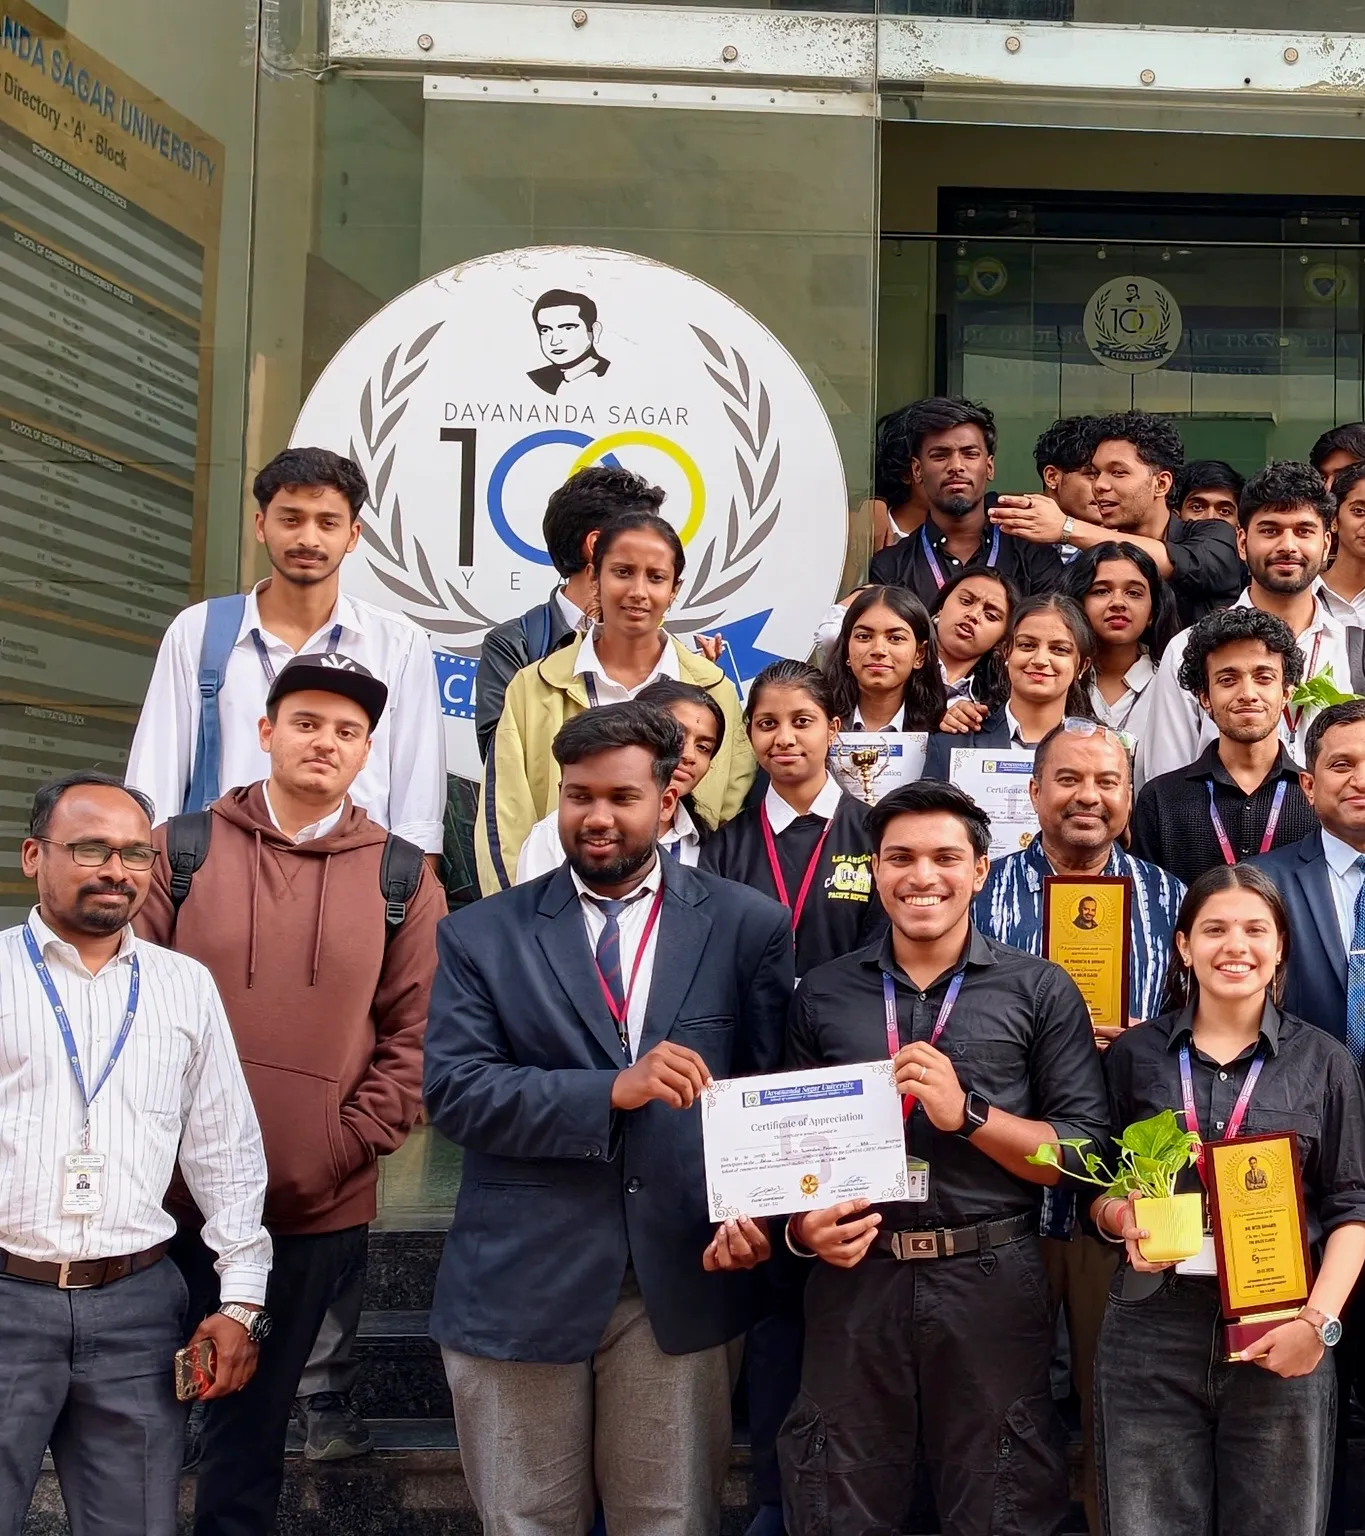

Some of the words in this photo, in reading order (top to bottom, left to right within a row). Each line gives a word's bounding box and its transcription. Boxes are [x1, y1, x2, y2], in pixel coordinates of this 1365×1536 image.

[0, 15, 46, 76] NDA
[51, 51, 116, 122] SAGAR
[120, 96, 216, 186] UNIVERSITY
[4, 71, 61, 131] Directory
[95, 135, 128, 172] Block
[32, 143, 54, 164] SCHOOL
[14, 231, 36, 252] SCHOOL
[445, 401, 596, 424] DAYANANDA
[608, 405, 689, 427] SAGAR
[751, 1120, 796, 1132] Certificate
[798, 1117, 808, 1127] of
[809, 1112, 864, 1127] Appreciation
